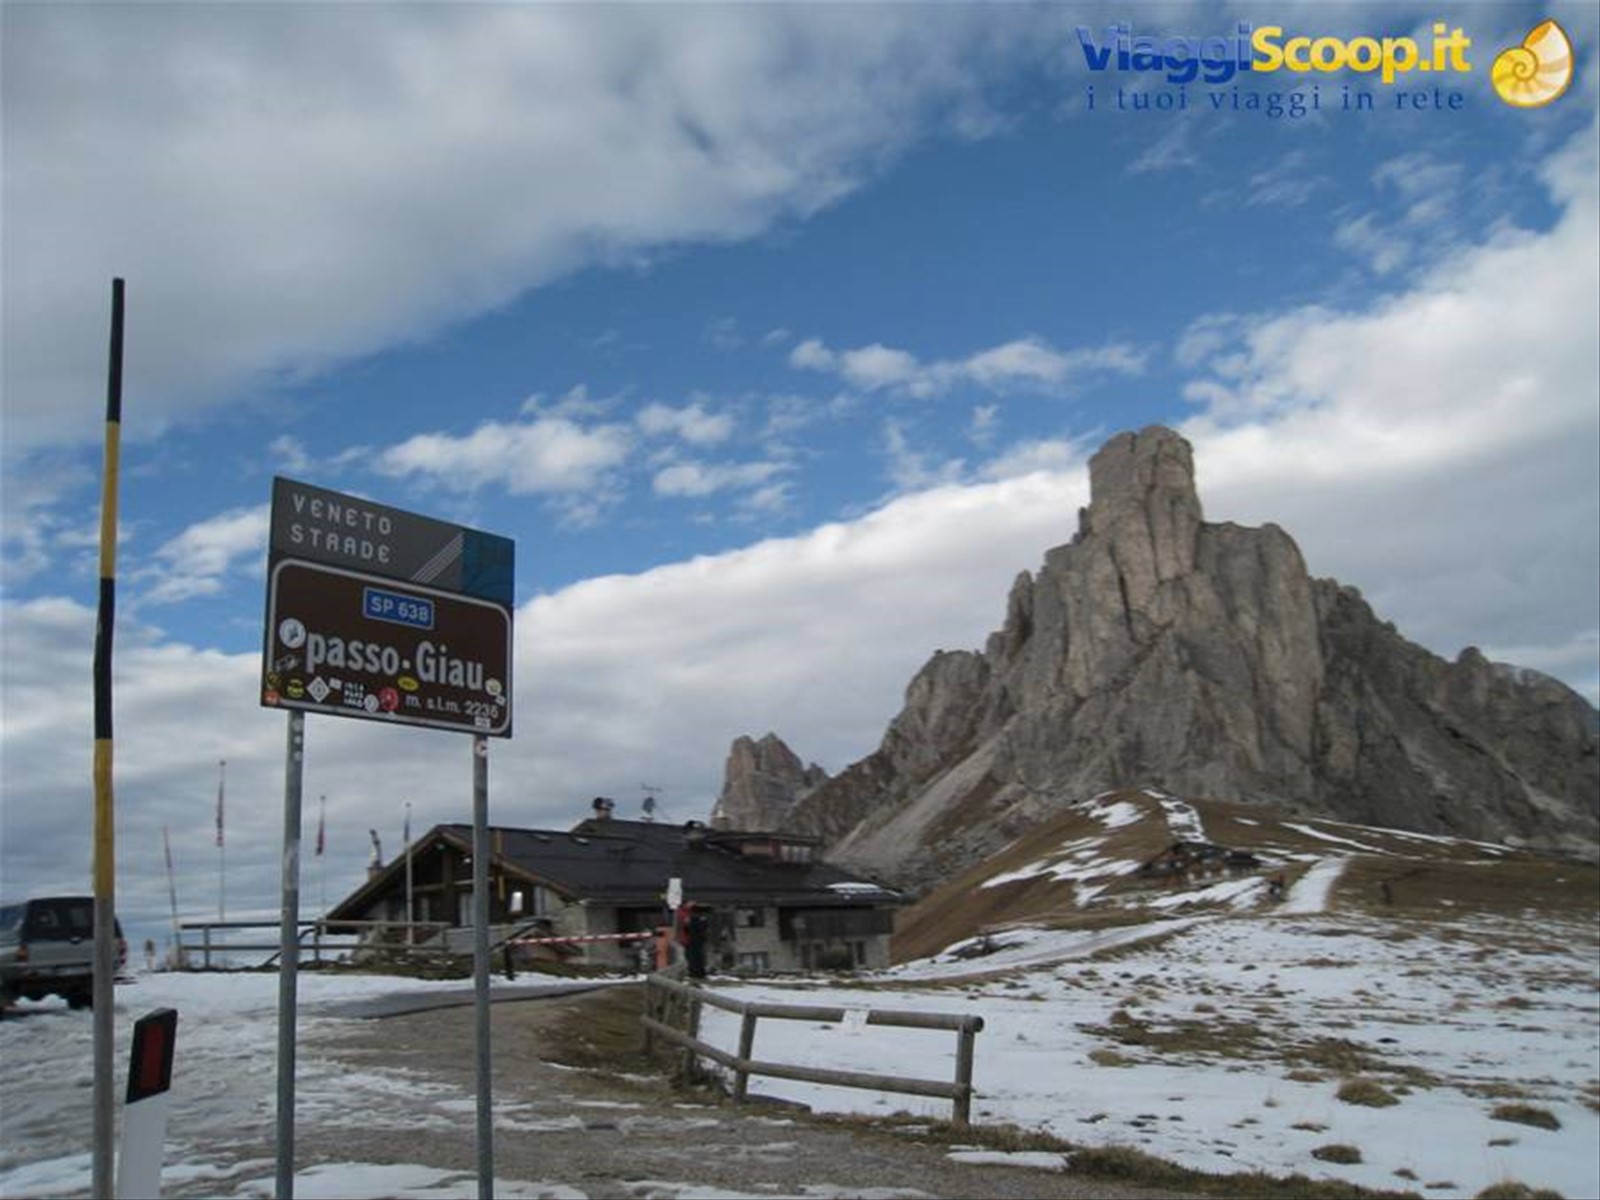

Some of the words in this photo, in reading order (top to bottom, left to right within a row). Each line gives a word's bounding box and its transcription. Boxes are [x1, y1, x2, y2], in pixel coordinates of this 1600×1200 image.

[292, 493, 393, 536] VENETO
[289, 523, 391, 564] STRADE
[370, 596, 394, 614] SP
[306, 632, 398, 676] passo
[415, 640, 484, 691] Giau
